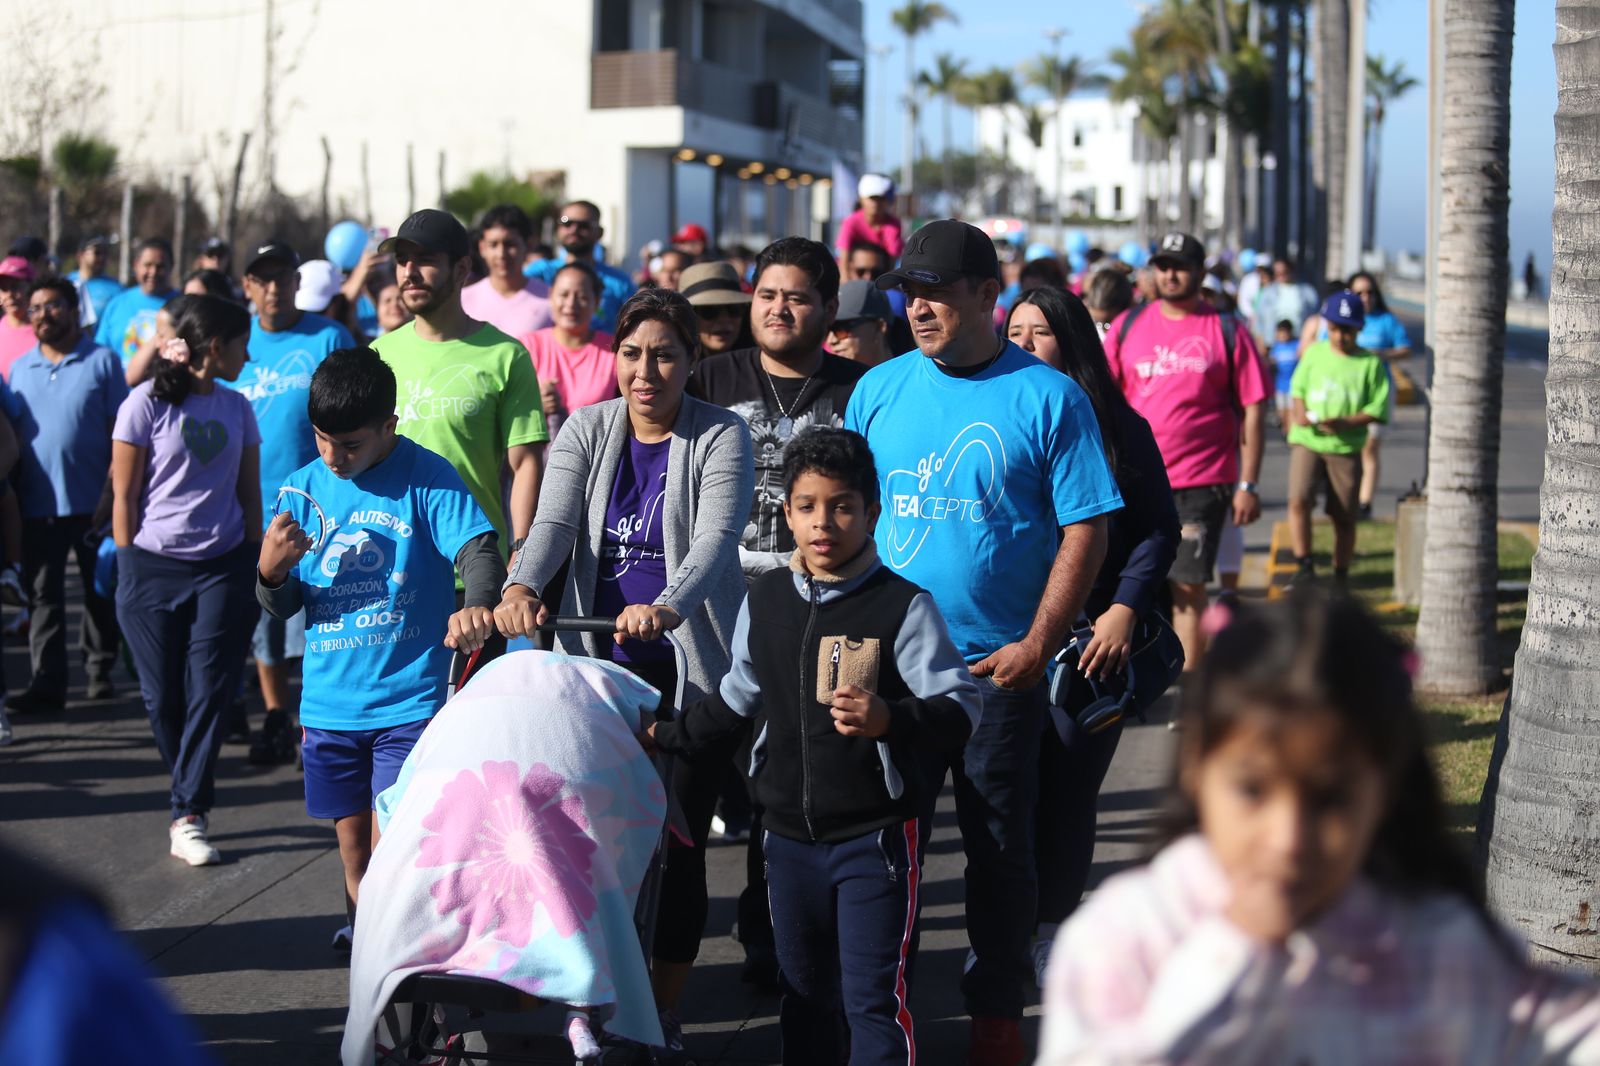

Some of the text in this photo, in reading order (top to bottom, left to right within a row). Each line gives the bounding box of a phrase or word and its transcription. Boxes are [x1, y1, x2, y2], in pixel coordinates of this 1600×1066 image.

[893, 494, 987, 522] TEACEPTO
[348, 511, 413, 538] AUTISMO
[348, 594, 392, 613] PUEDE
[395, 588, 418, 607] QUE
[316, 609, 405, 634] TUS OJOS
[320, 634, 363, 653] PIERDAN
[367, 632, 386, 646] DE
[388, 625, 421, 643] ALGO
